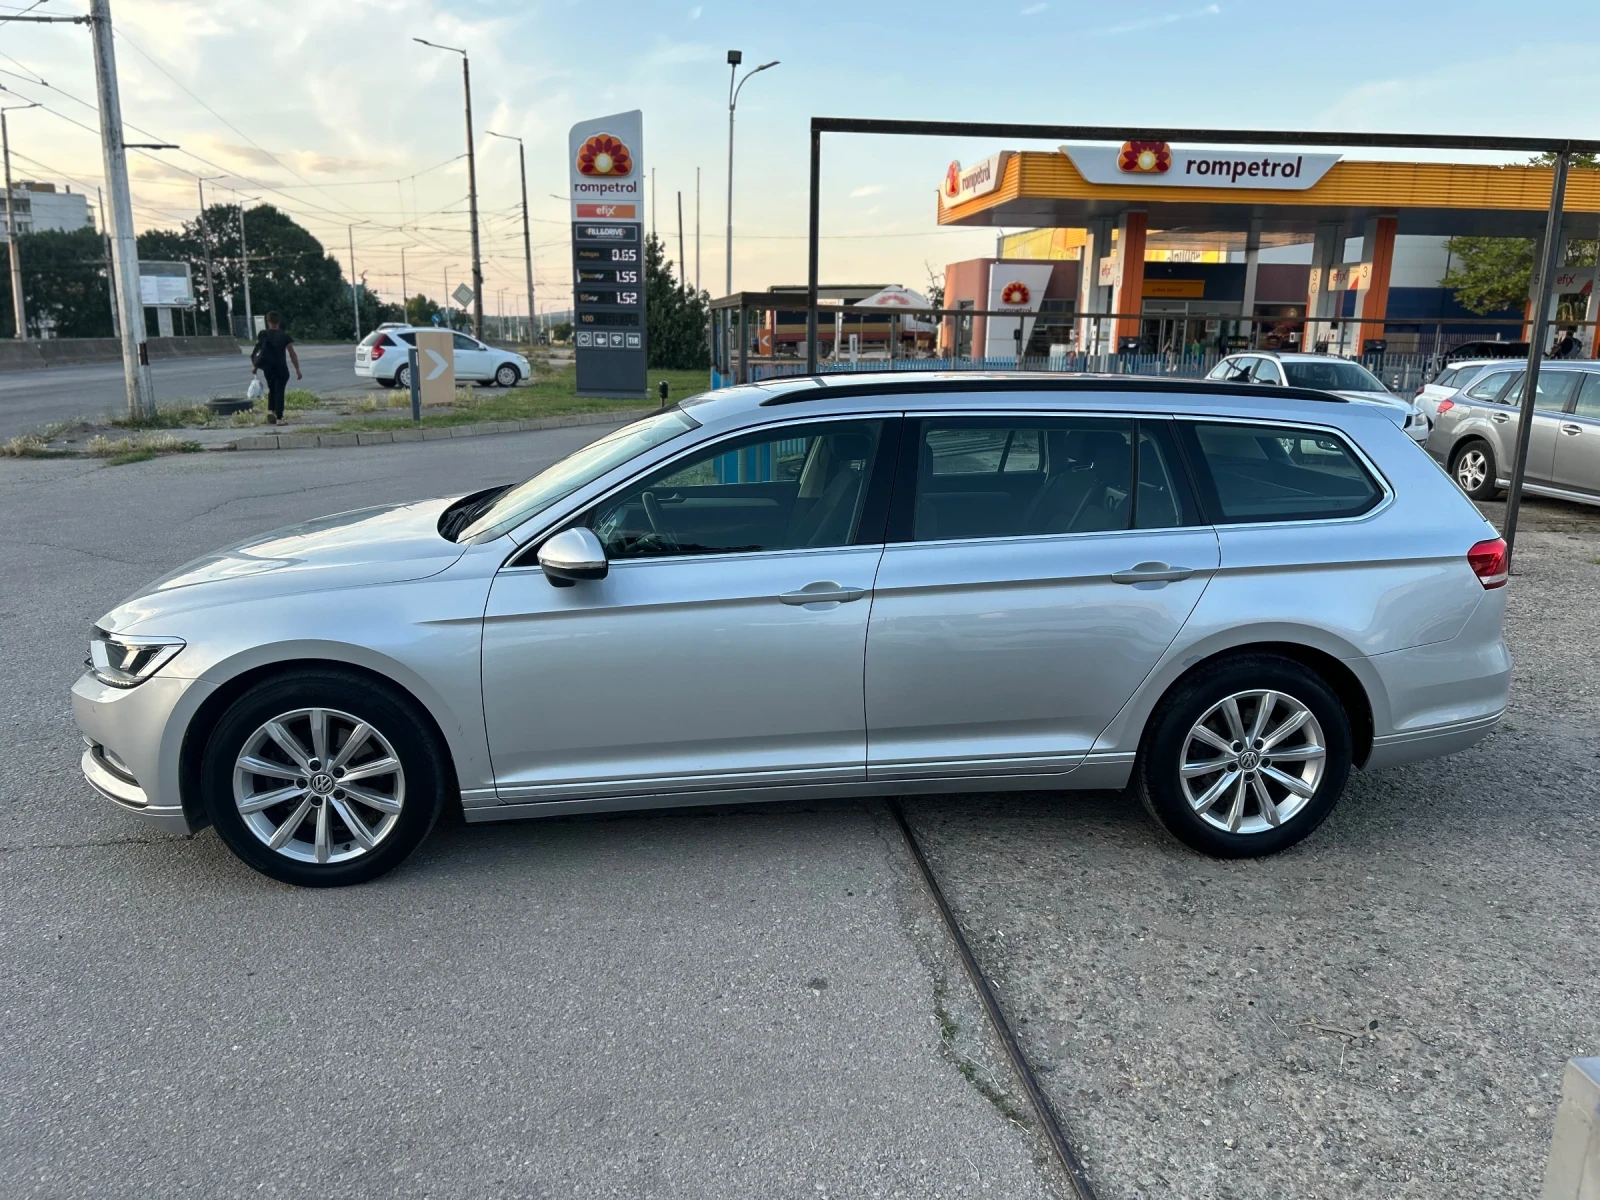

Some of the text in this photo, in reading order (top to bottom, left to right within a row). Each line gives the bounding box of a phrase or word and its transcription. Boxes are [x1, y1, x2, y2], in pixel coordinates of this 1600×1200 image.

[1185, 155, 1303, 183] rompetrol
[962, 159, 991, 193] rompetrol
[574, 181, 637, 196] rompetrol
[596, 205, 616, 217] efix
[588, 228, 623, 236] FILL&DRIVE
[611, 248, 637, 261] 0.65
[616, 270, 637, 282] 1.55
[1312, 270, 1318, 281] 3
[1333, 270, 1348, 284] efix
[1362, 266, 1368, 278] 3
[1557, 274, 1576, 287] efix
[616, 291, 637, 304] 1.52
[582, 315, 594, 323] 100
[628, 336, 639, 344] TIR
